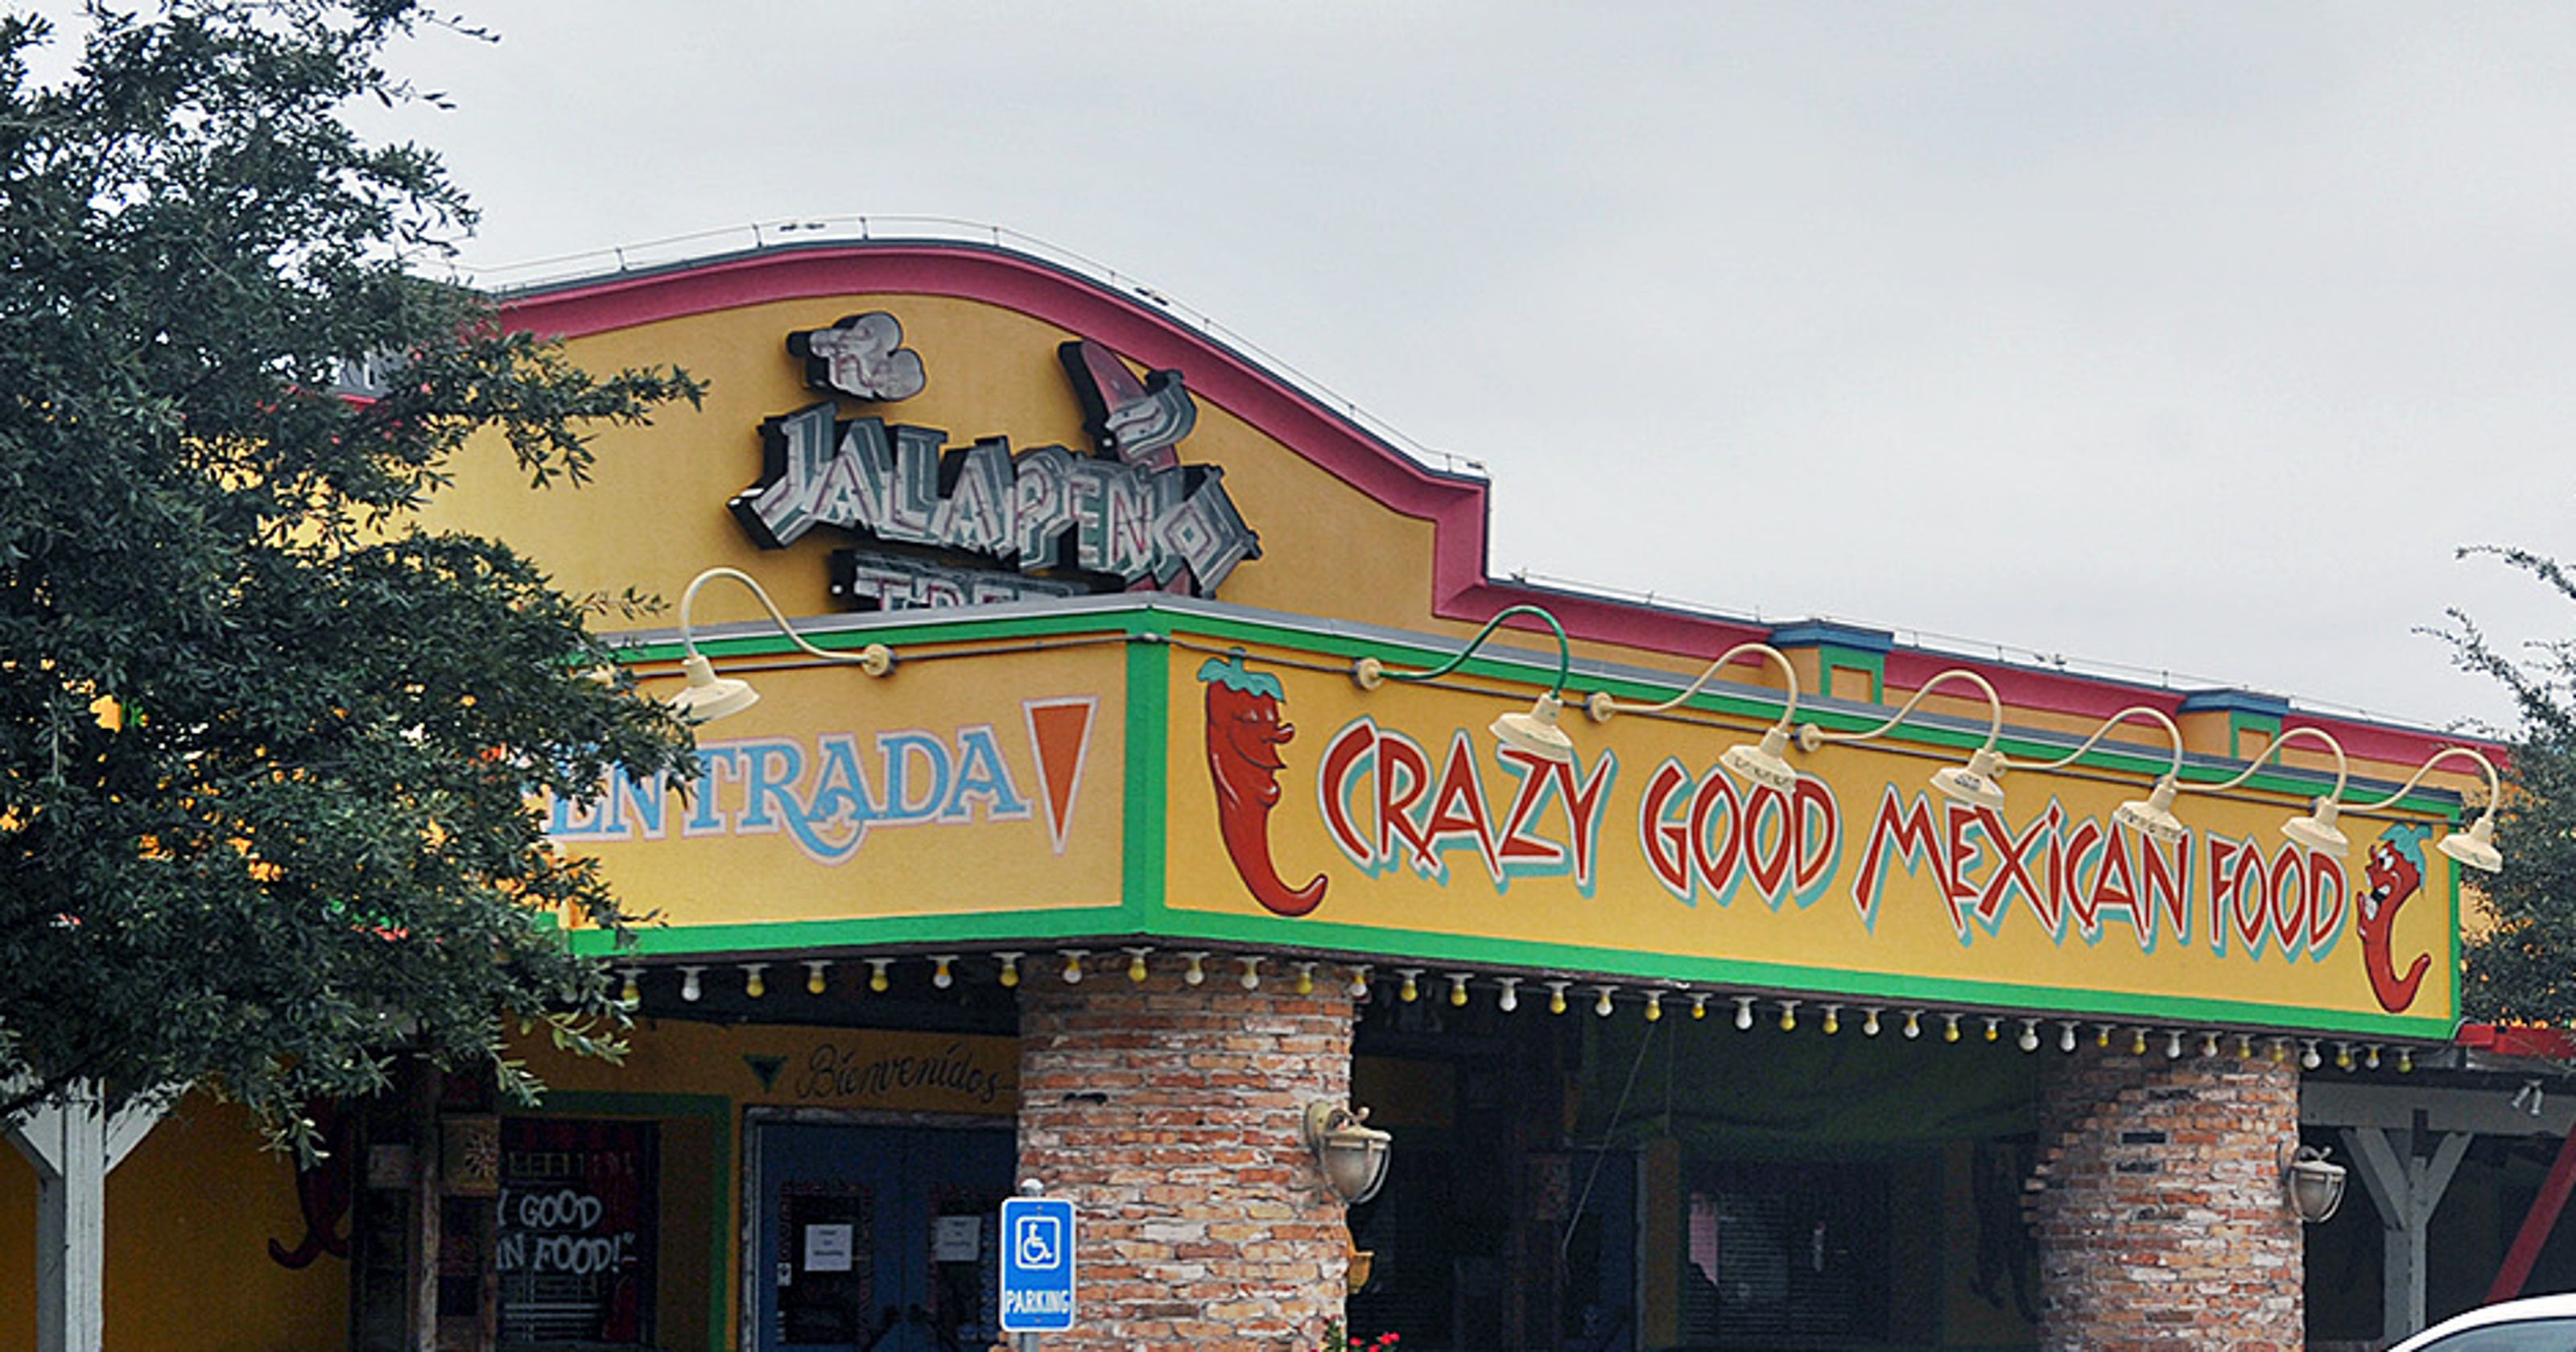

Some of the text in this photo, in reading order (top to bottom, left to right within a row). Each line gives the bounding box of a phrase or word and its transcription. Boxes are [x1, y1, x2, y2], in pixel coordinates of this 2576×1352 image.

[1317, 713, 2349, 962] CRAZY GOOD MEXICAN FOOD
[519, 1188, 603, 1230] GOOD
[1005, 1289, 1069, 1314] PARKING
